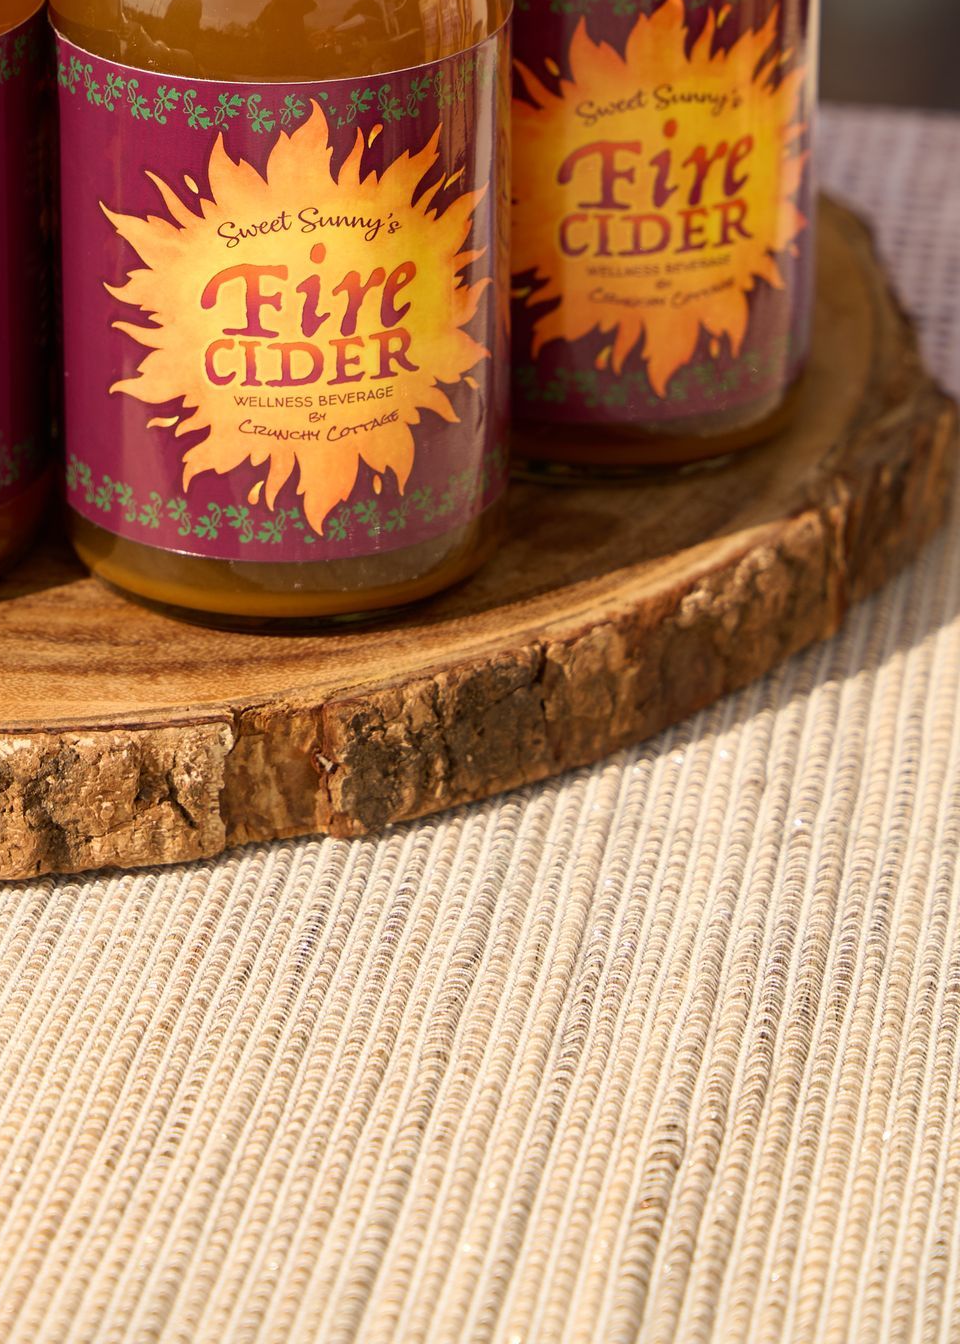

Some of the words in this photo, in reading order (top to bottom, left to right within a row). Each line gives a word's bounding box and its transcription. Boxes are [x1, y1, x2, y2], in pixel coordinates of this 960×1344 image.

[575, 89, 646, 126] Sweet
[653, 84, 743, 117] Sunny's
[557, 118, 753, 209] Fire
[217, 211, 292, 248] Sweet
[297, 207, 402, 241] Sunny's
[558, 199, 752, 257] CIDER
[200, 243, 416, 338] Fire
[204, 326, 420, 389] CIDER
[234, 395, 314, 408] WELLNESS
[318, 386, 394, 407] BEVERAGE
